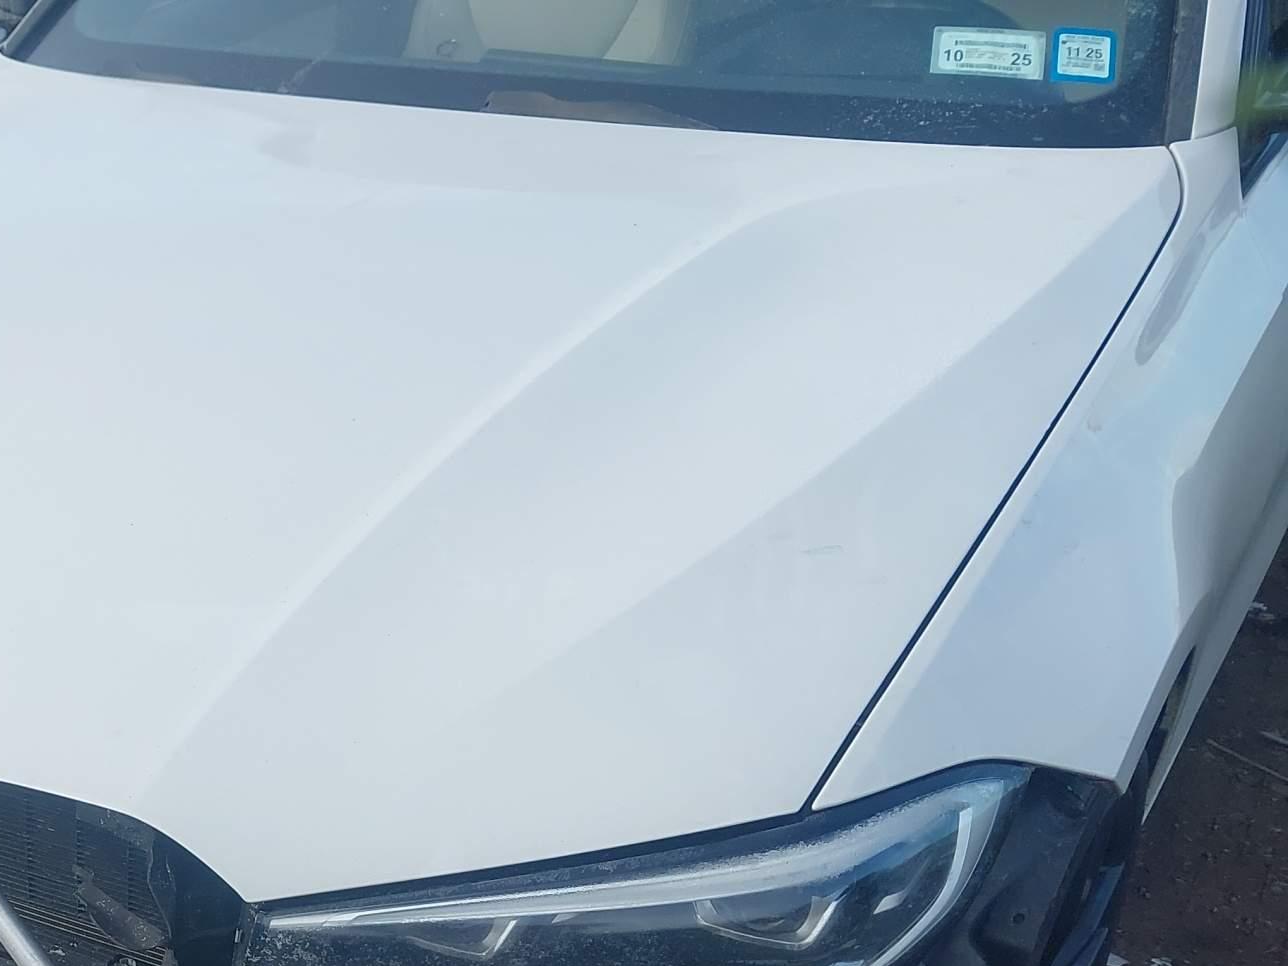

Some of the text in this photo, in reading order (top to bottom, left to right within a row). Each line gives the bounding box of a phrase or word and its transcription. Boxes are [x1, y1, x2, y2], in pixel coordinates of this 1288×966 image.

[943, 48, 964, 62] 10
[1011, 52, 1033, 66] 25
[1066, 46, 1104, 59] 11 25
